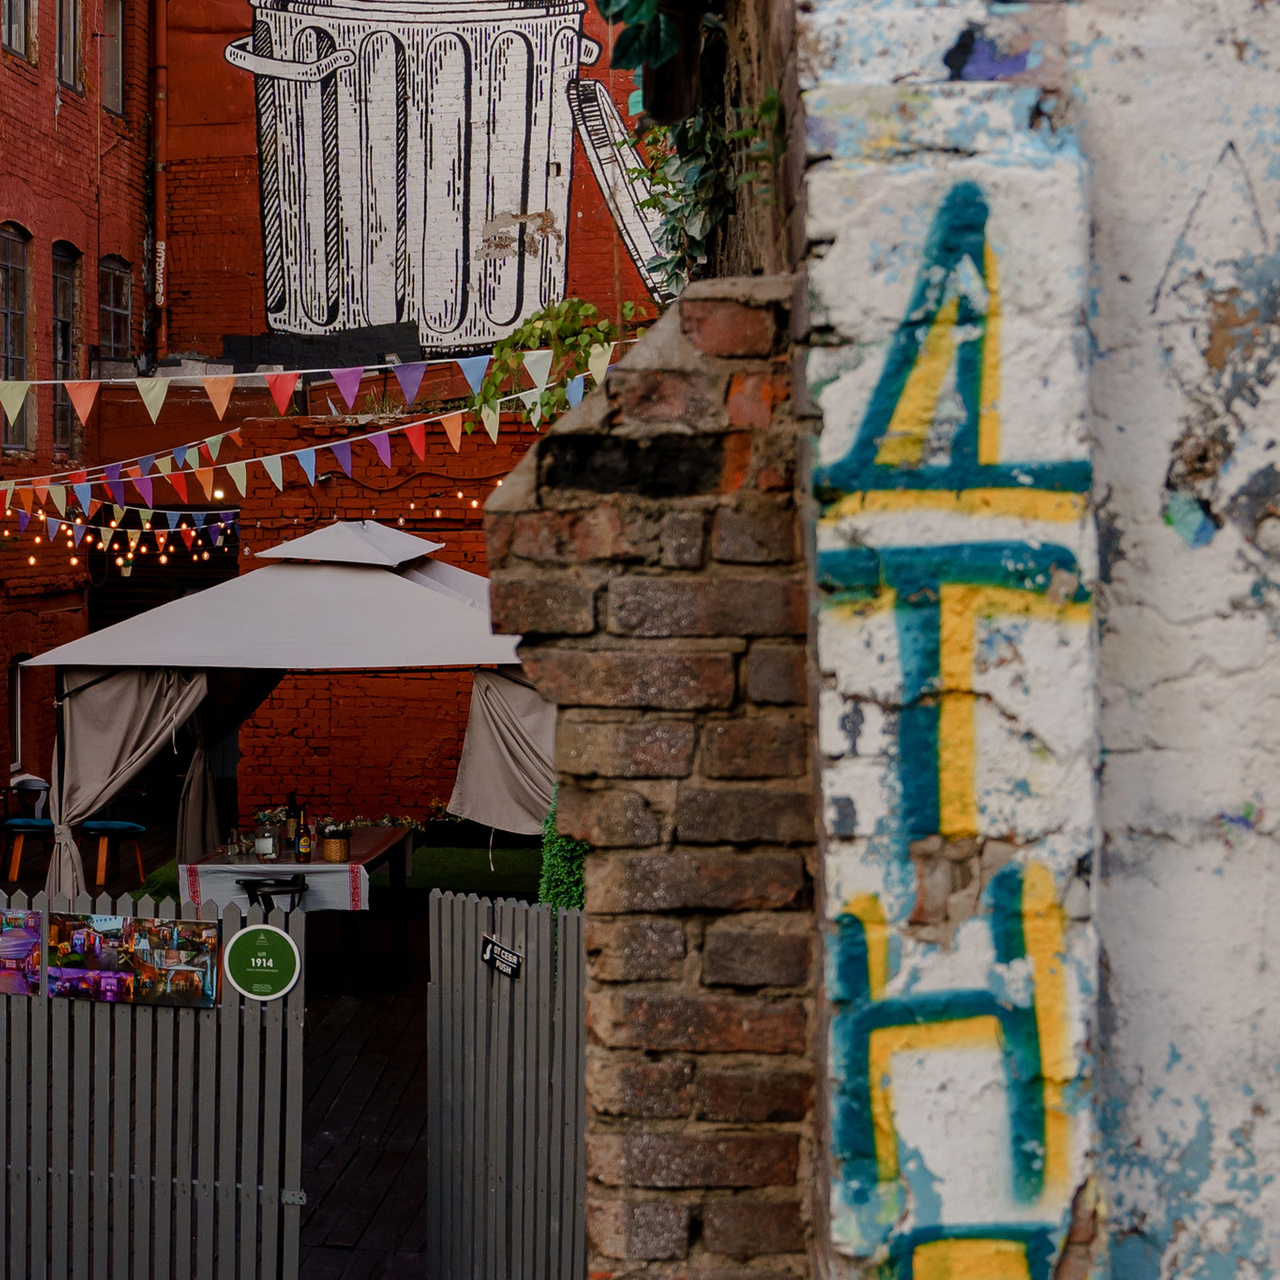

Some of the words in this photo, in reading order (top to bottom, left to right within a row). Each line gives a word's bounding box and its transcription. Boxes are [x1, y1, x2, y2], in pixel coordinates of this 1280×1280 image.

[250, 957, 274, 968] 1914
[493, 945, 501, 956] ОТ
[500, 949, 518, 965] СЕБЯ
[495, 959, 512, 975] PUSH
